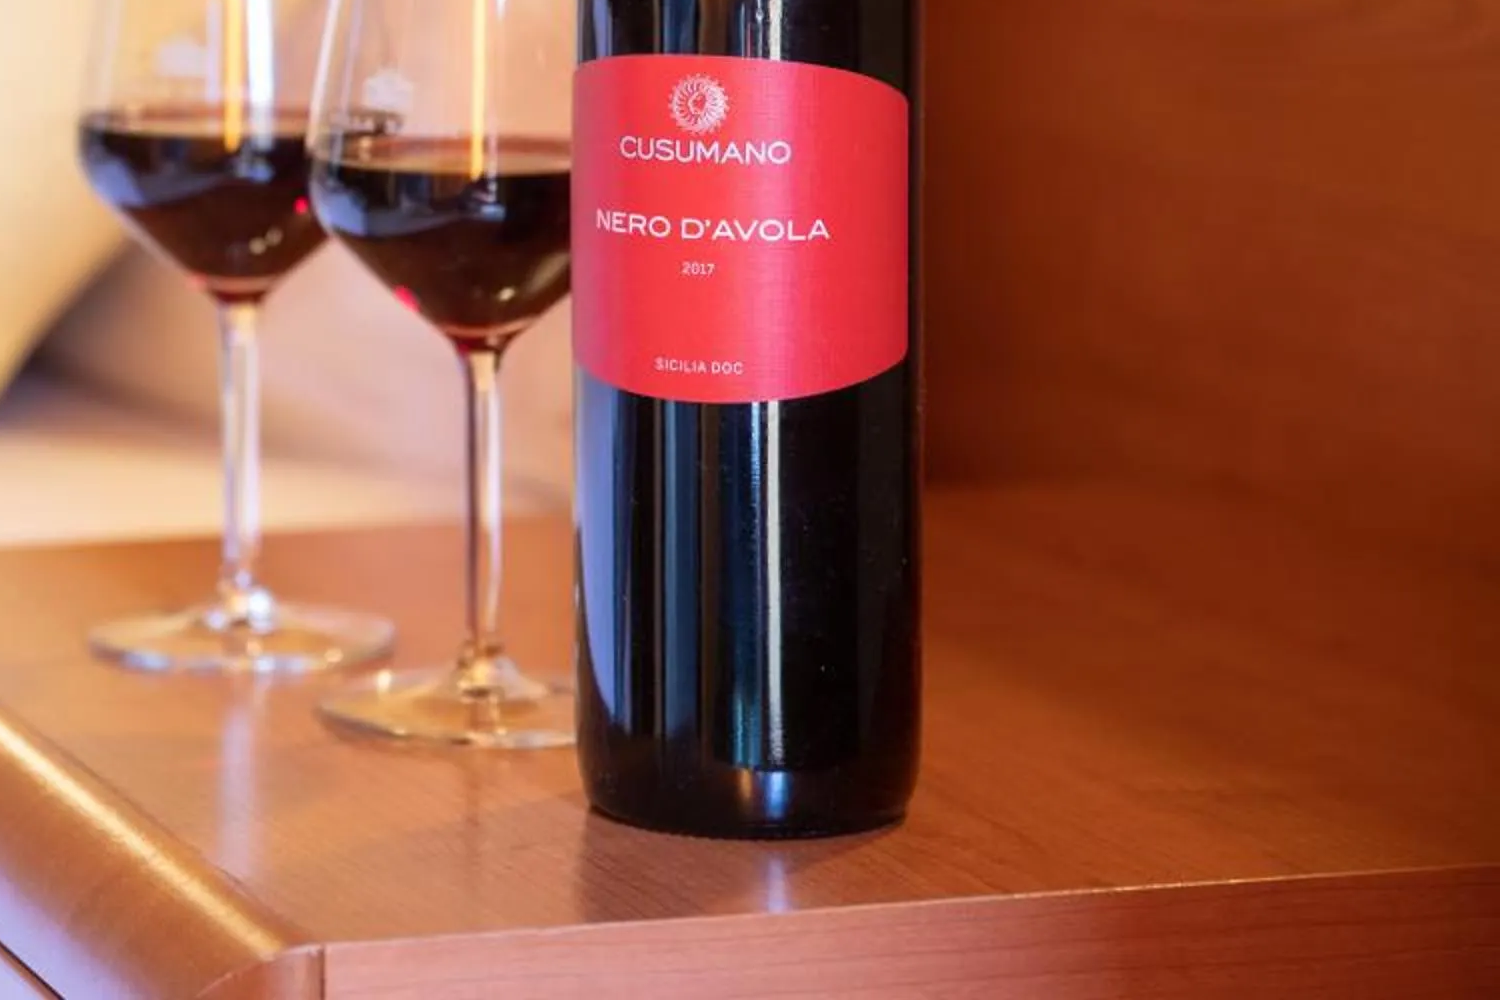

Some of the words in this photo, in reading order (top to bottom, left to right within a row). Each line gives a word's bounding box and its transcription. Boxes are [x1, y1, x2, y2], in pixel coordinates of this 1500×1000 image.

[619, 135, 792, 165] CUSUMANO
[596, 208, 672, 238] NERO
[680, 217, 831, 242] D'AVOLA
[681, 261, 716, 277] 2017
[653, 356, 708, 374] SICILIA
[711, 361, 744, 376] DOC
